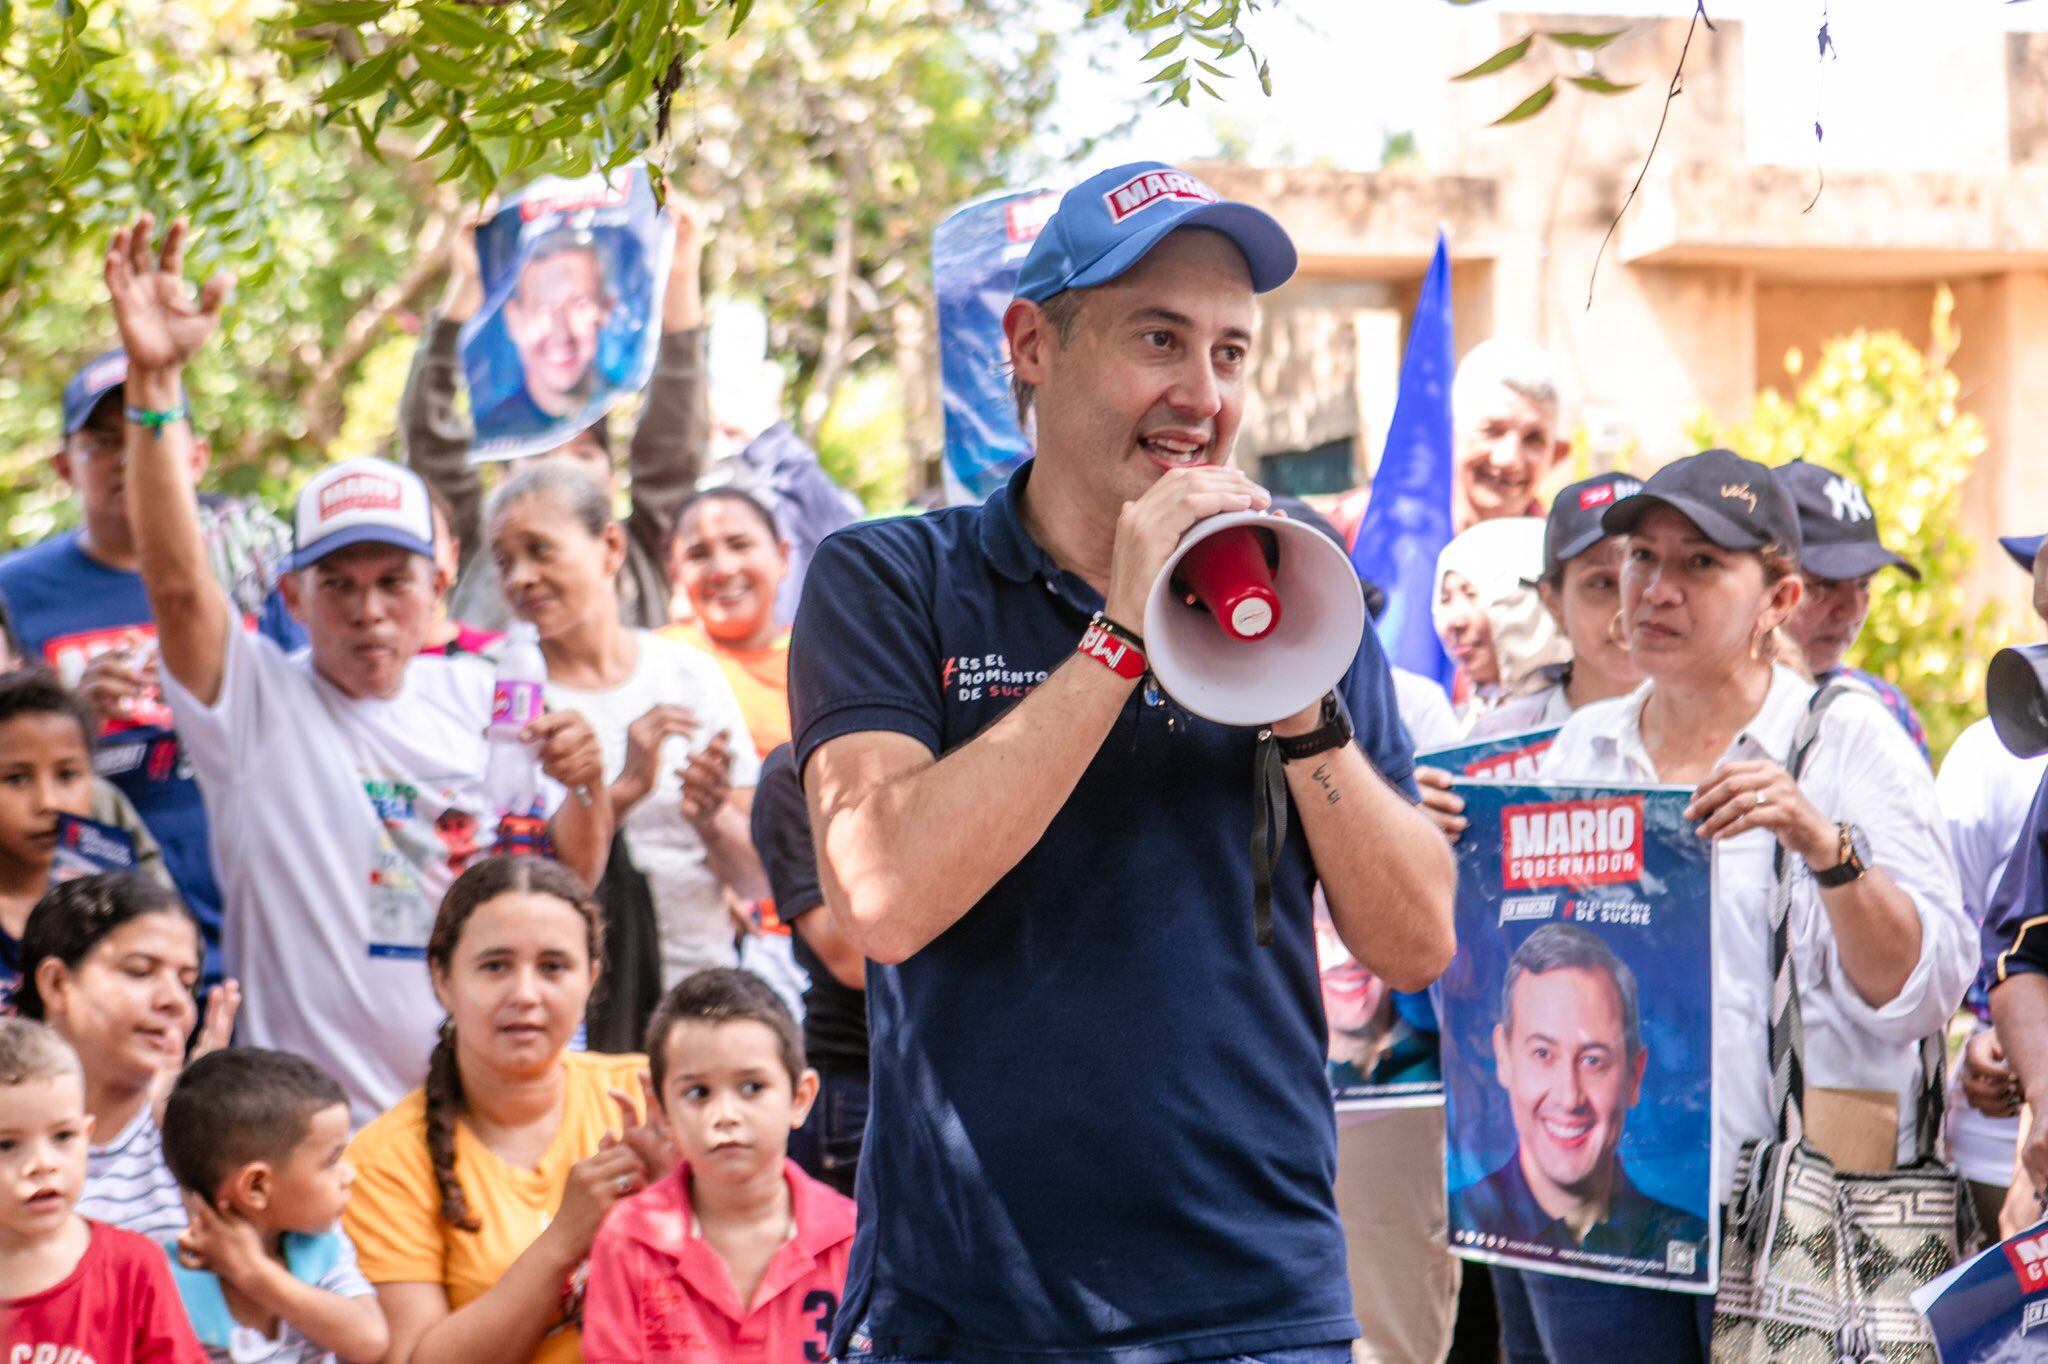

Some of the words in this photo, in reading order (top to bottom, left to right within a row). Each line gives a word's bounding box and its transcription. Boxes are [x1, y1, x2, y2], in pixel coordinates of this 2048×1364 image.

[959, 657, 981, 671] ES
[984, 654, 1006, 668] EL
[959, 669, 1049, 686] MOMENTO
[959, 688, 982, 702] DE
[989, 685, 1034, 698] SUC
[1510, 805, 1635, 859] MARIO
[1510, 852, 1635, 881] GOBERNADOR
[11, 1341, 97, 1364] CRU
